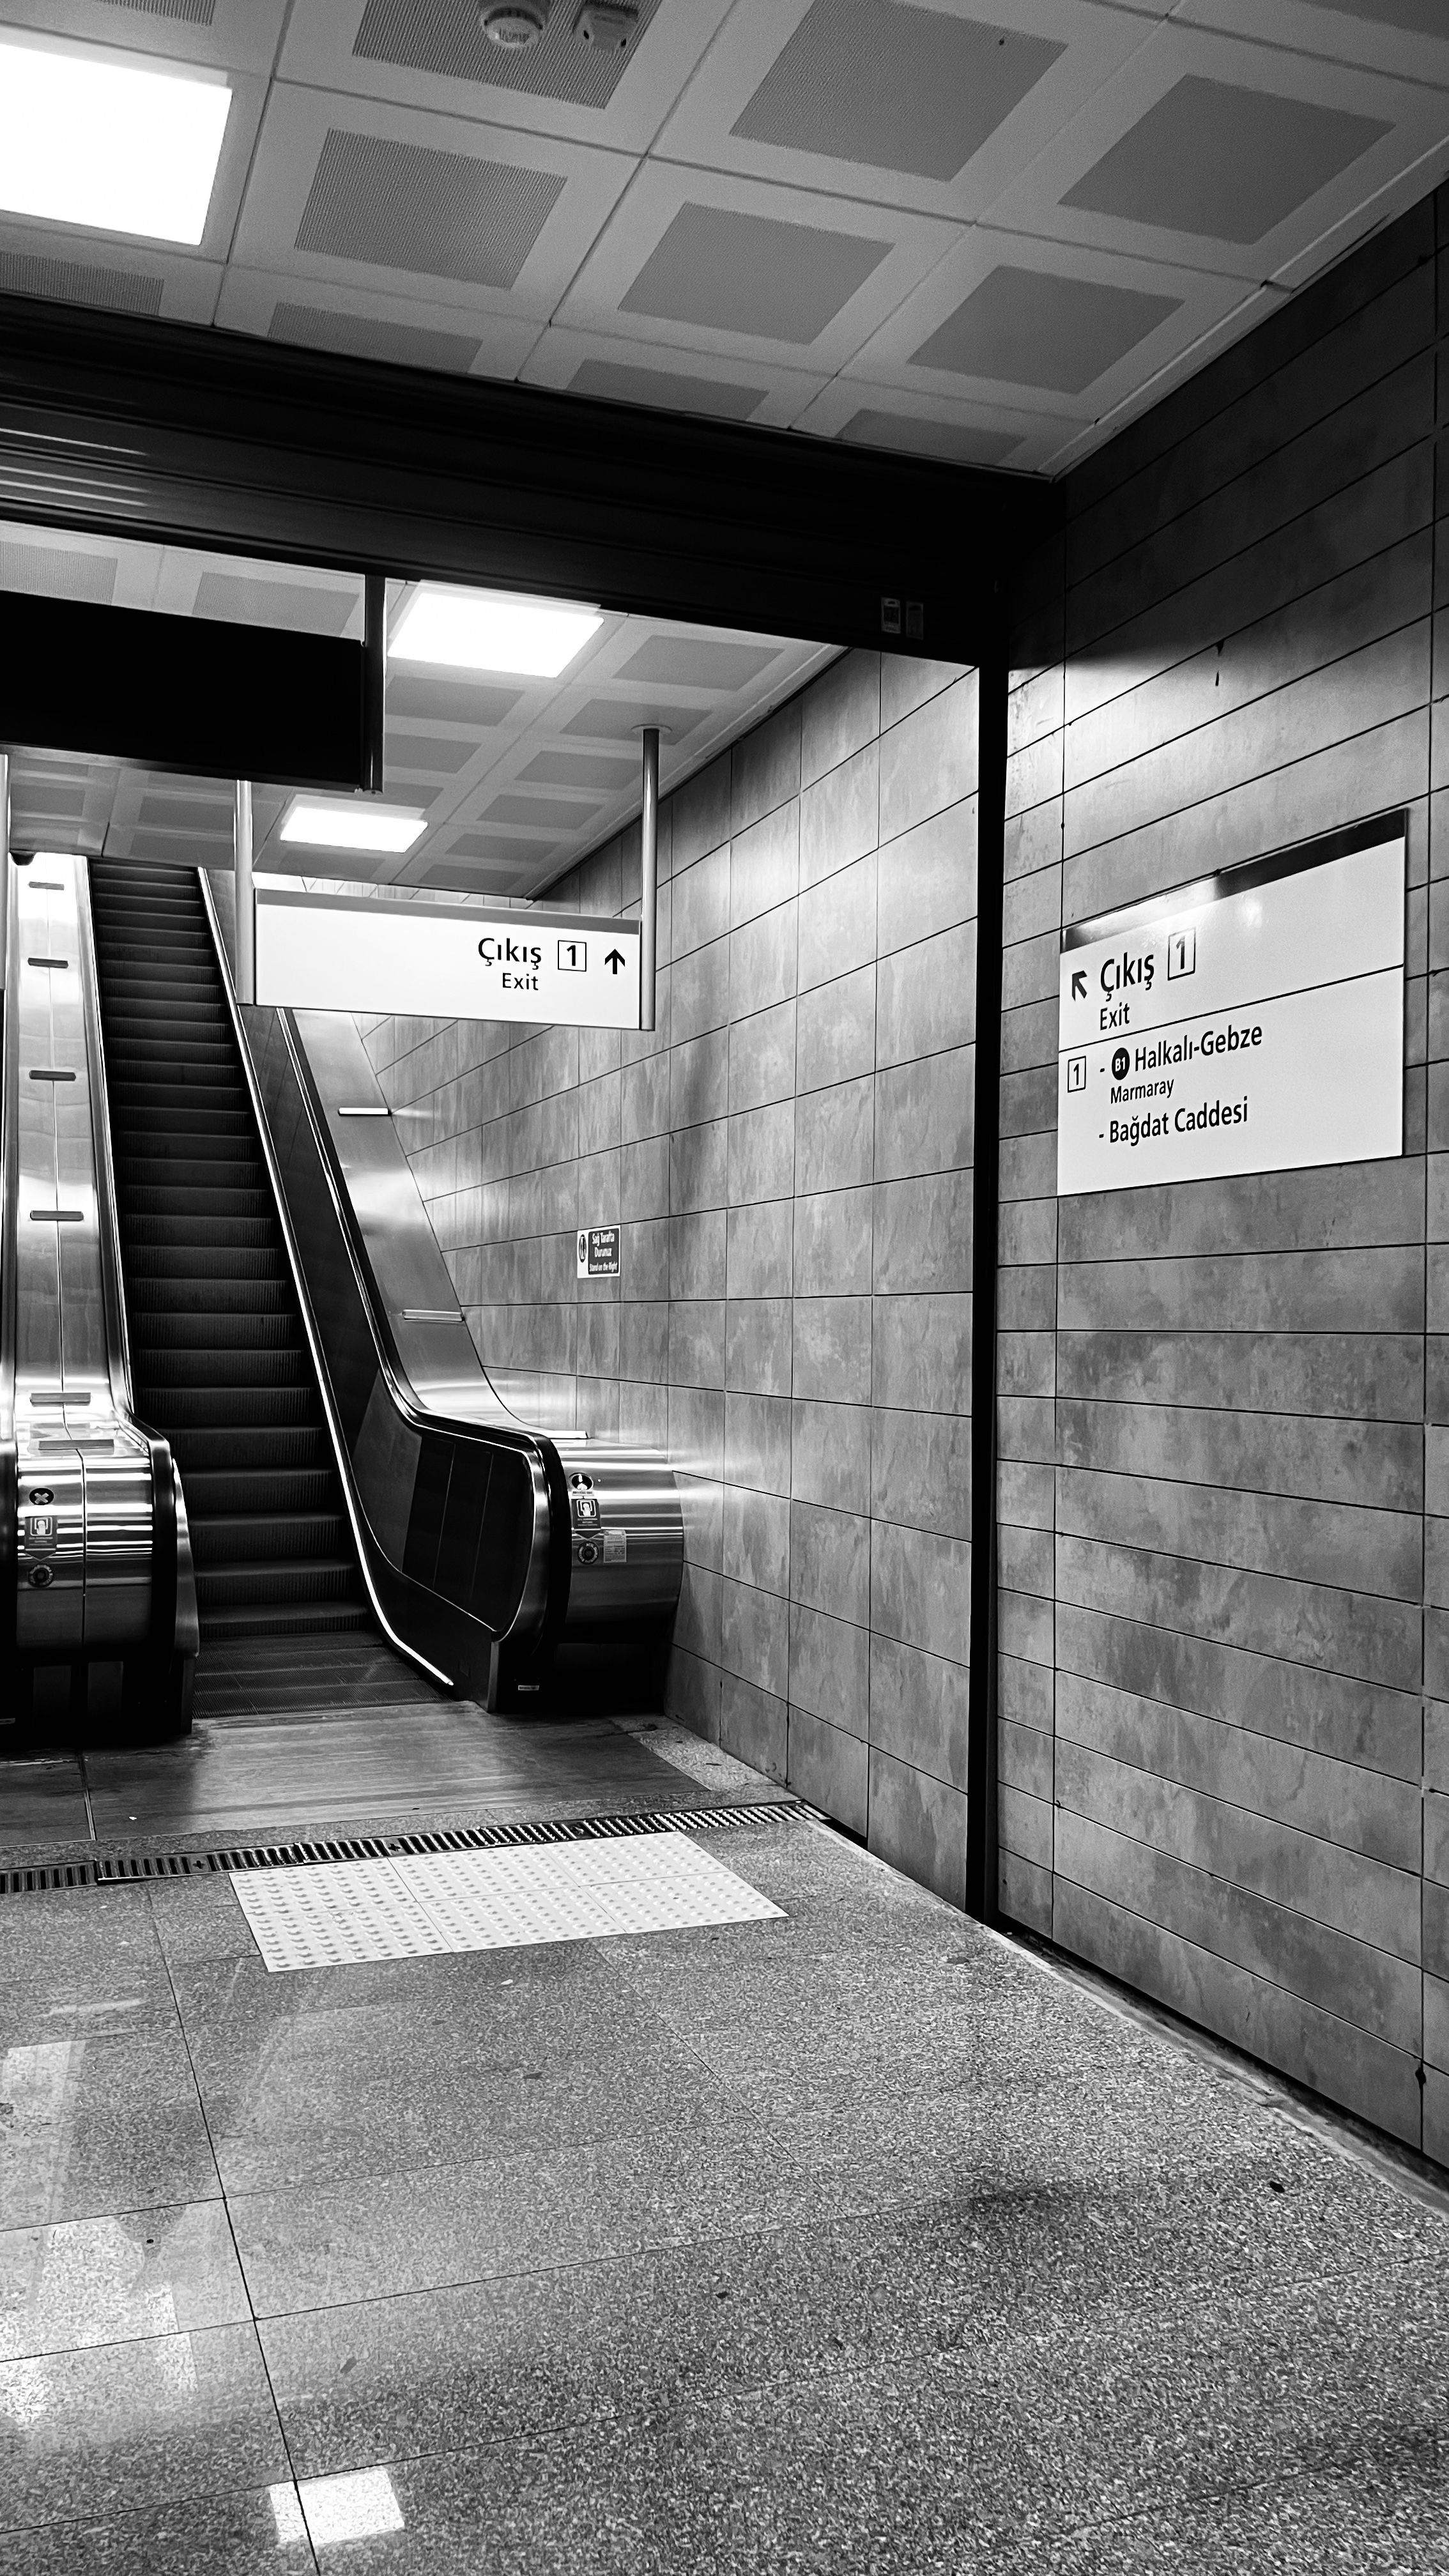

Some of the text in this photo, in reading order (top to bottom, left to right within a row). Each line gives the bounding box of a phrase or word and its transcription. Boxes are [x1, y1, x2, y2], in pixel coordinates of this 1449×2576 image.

[478, 937, 576, 970] Çıkış 1
[1100, 937, 1185, 1002] Çıkış 1
[502, 972, 539, 991] Exit
[1100, 1002, 1130, 1031] Exit
[1073, 1063, 1080, 1085] 1
[1115, 1057, 1126, 1072] B1
[1135, 1025, 1263, 1072] Halkalı-Gebze
[1110, 1078, 1174, 1105] Marmaray
[1110, 1112, 1169, 1147] Bağdat
[1174, 1095, 1248, 1133] Caddesi
